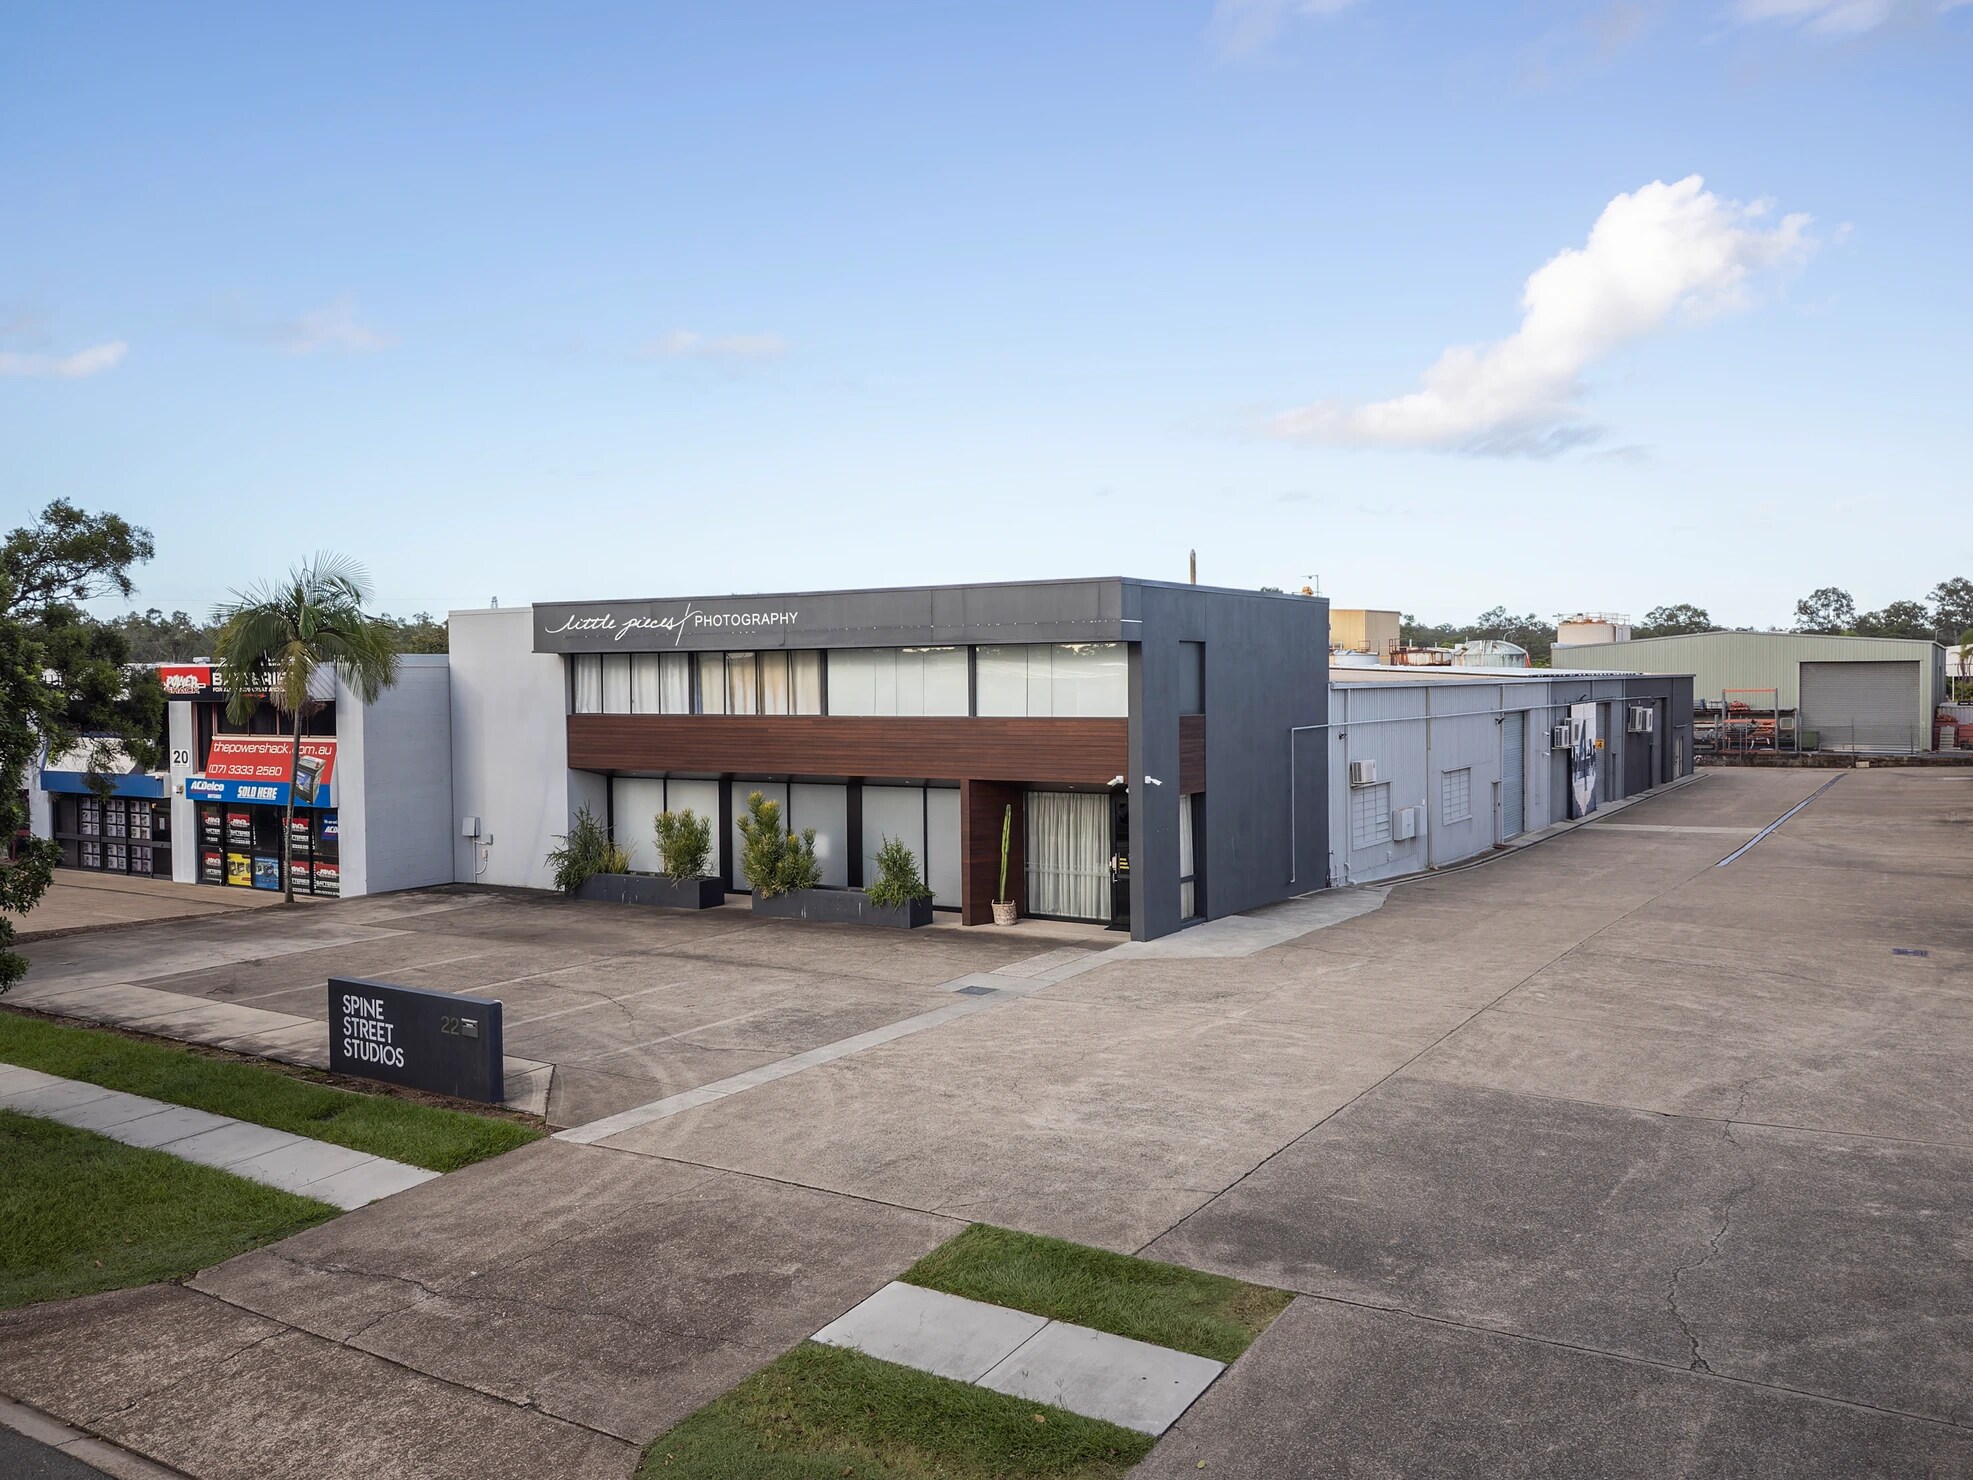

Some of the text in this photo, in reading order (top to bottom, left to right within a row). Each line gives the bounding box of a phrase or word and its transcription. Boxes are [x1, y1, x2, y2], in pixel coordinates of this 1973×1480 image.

[694, 611, 799, 628] PHOTOGRAPHY
[165, 674, 199, 688] POWER
[213, 742, 332, 755] thepowershack.om.au
[173, 750, 189, 764] 20
[208, 764, 283, 776] (07) 3333 2580
[190, 781, 225, 791] ACDelco
[237, 786, 278, 799] SOLD HERE
[342, 993, 385, 1020] SPINE
[342, 1016, 394, 1044] STREET
[440, 1015, 460, 1035] 22
[343, 1037, 405, 1068] STUDIOS
